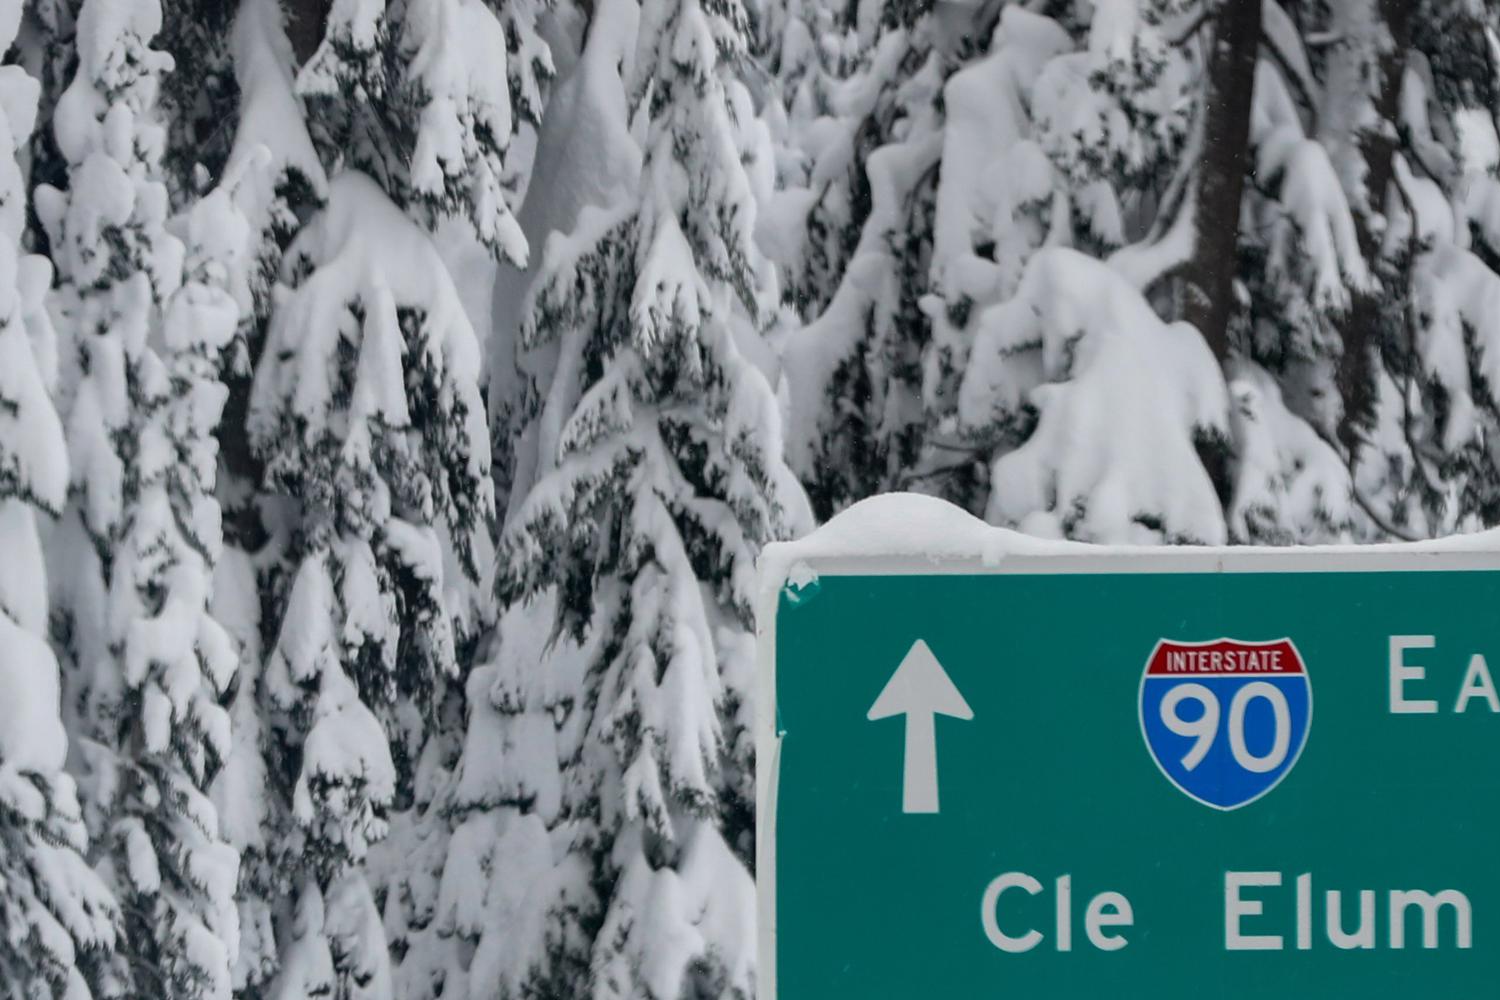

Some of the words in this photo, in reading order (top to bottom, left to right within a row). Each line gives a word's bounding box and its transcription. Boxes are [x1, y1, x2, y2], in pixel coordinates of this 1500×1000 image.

[1166, 650, 1283, 672] INTERSTATE
[1159, 680, 1292, 774] 90
[981, 871, 1134, 953] Cle
[1224, 870, 1473, 951] Elum
